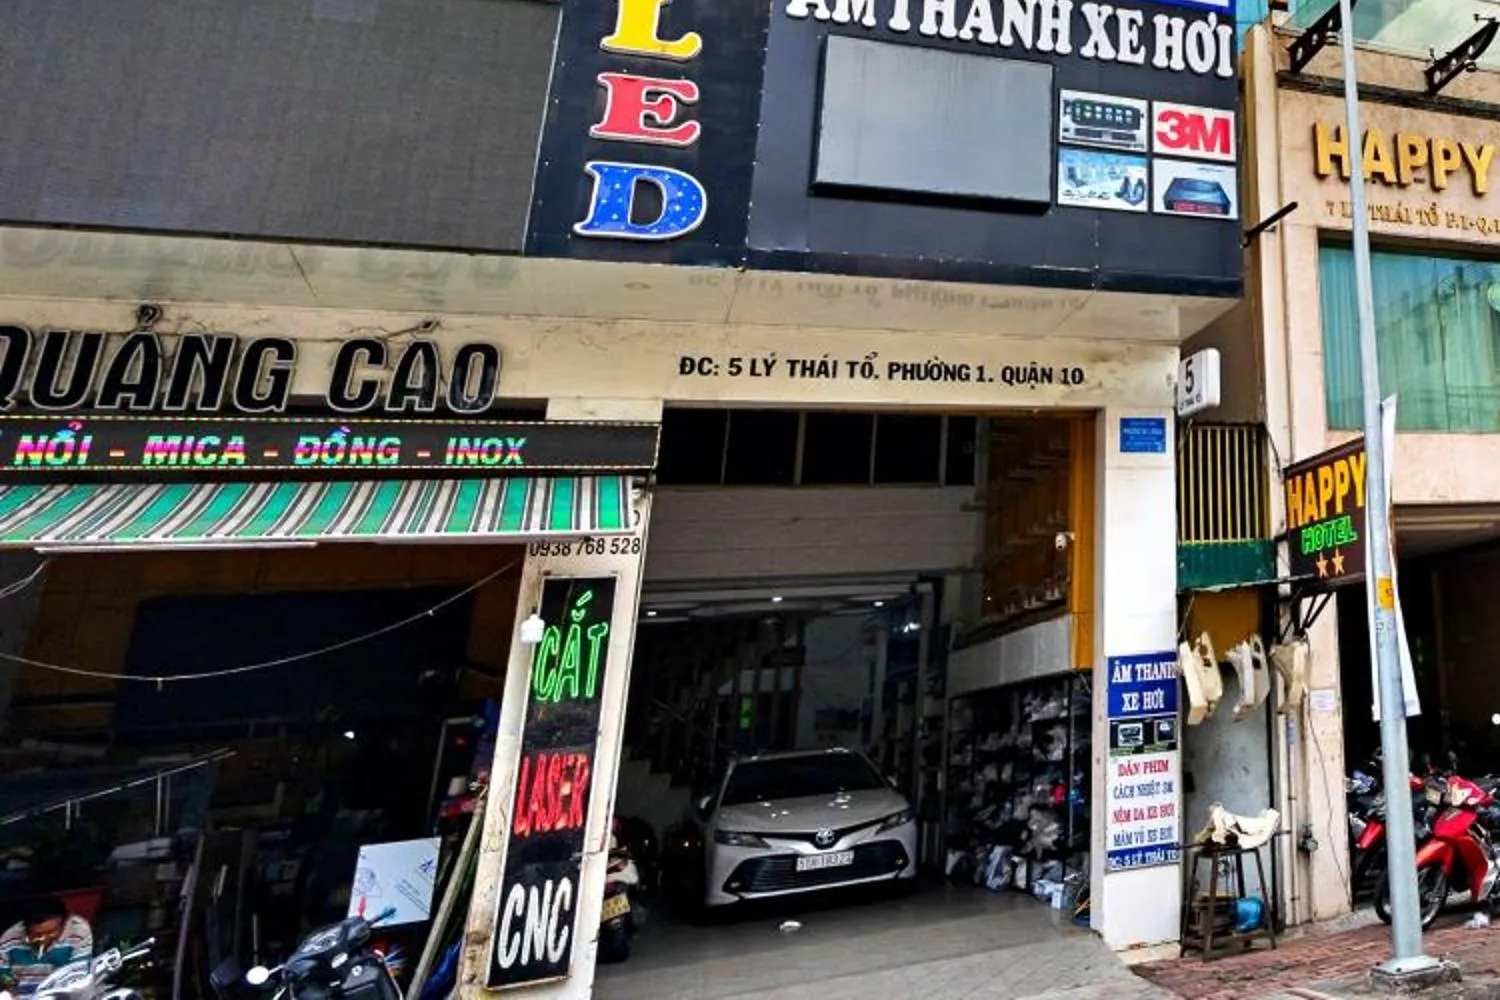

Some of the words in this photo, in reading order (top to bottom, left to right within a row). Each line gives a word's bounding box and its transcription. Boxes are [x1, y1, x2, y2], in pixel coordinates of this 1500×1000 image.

[1079, 2, 1146, 64] XE
[1152, 12, 1235, 78] HƠI
[1156, 110, 1231, 155] 3M
[1312, 120, 1496, 196] HAPPY
[0, 304, 296, 413] QUẢNG
[325, 319, 502, 413] CÁO
[679, 356, 720, 378] ĐC:
[727, 356, 743, 377] 5
[748, 351, 777, 379] LÝ
[786, 355, 838, 381] THÁI
[887, 358, 972, 384] PHƯỜNG
[1001, 366, 1054, 388] QUẬN
[1060, 367, 1084, 385] 10
[1186, 358, 1195, 394] 5
[14, 421, 93, 465] NỔI
[142, 435, 246, 465] MICA
[445, 437, 526, 466] INOX
[1286, 452, 1367, 529] HAPPY
[610, 538, 641, 555] 528
[1301, 516, 1358, 555] HOTEL
[533, 589, 609, 703] CẮT
[1121, 692, 1140, 712] XE
[1143, 760, 1169, 774] PHIM
[513, 750, 590, 836] LASER
[500, 876, 572, 969] CNC
